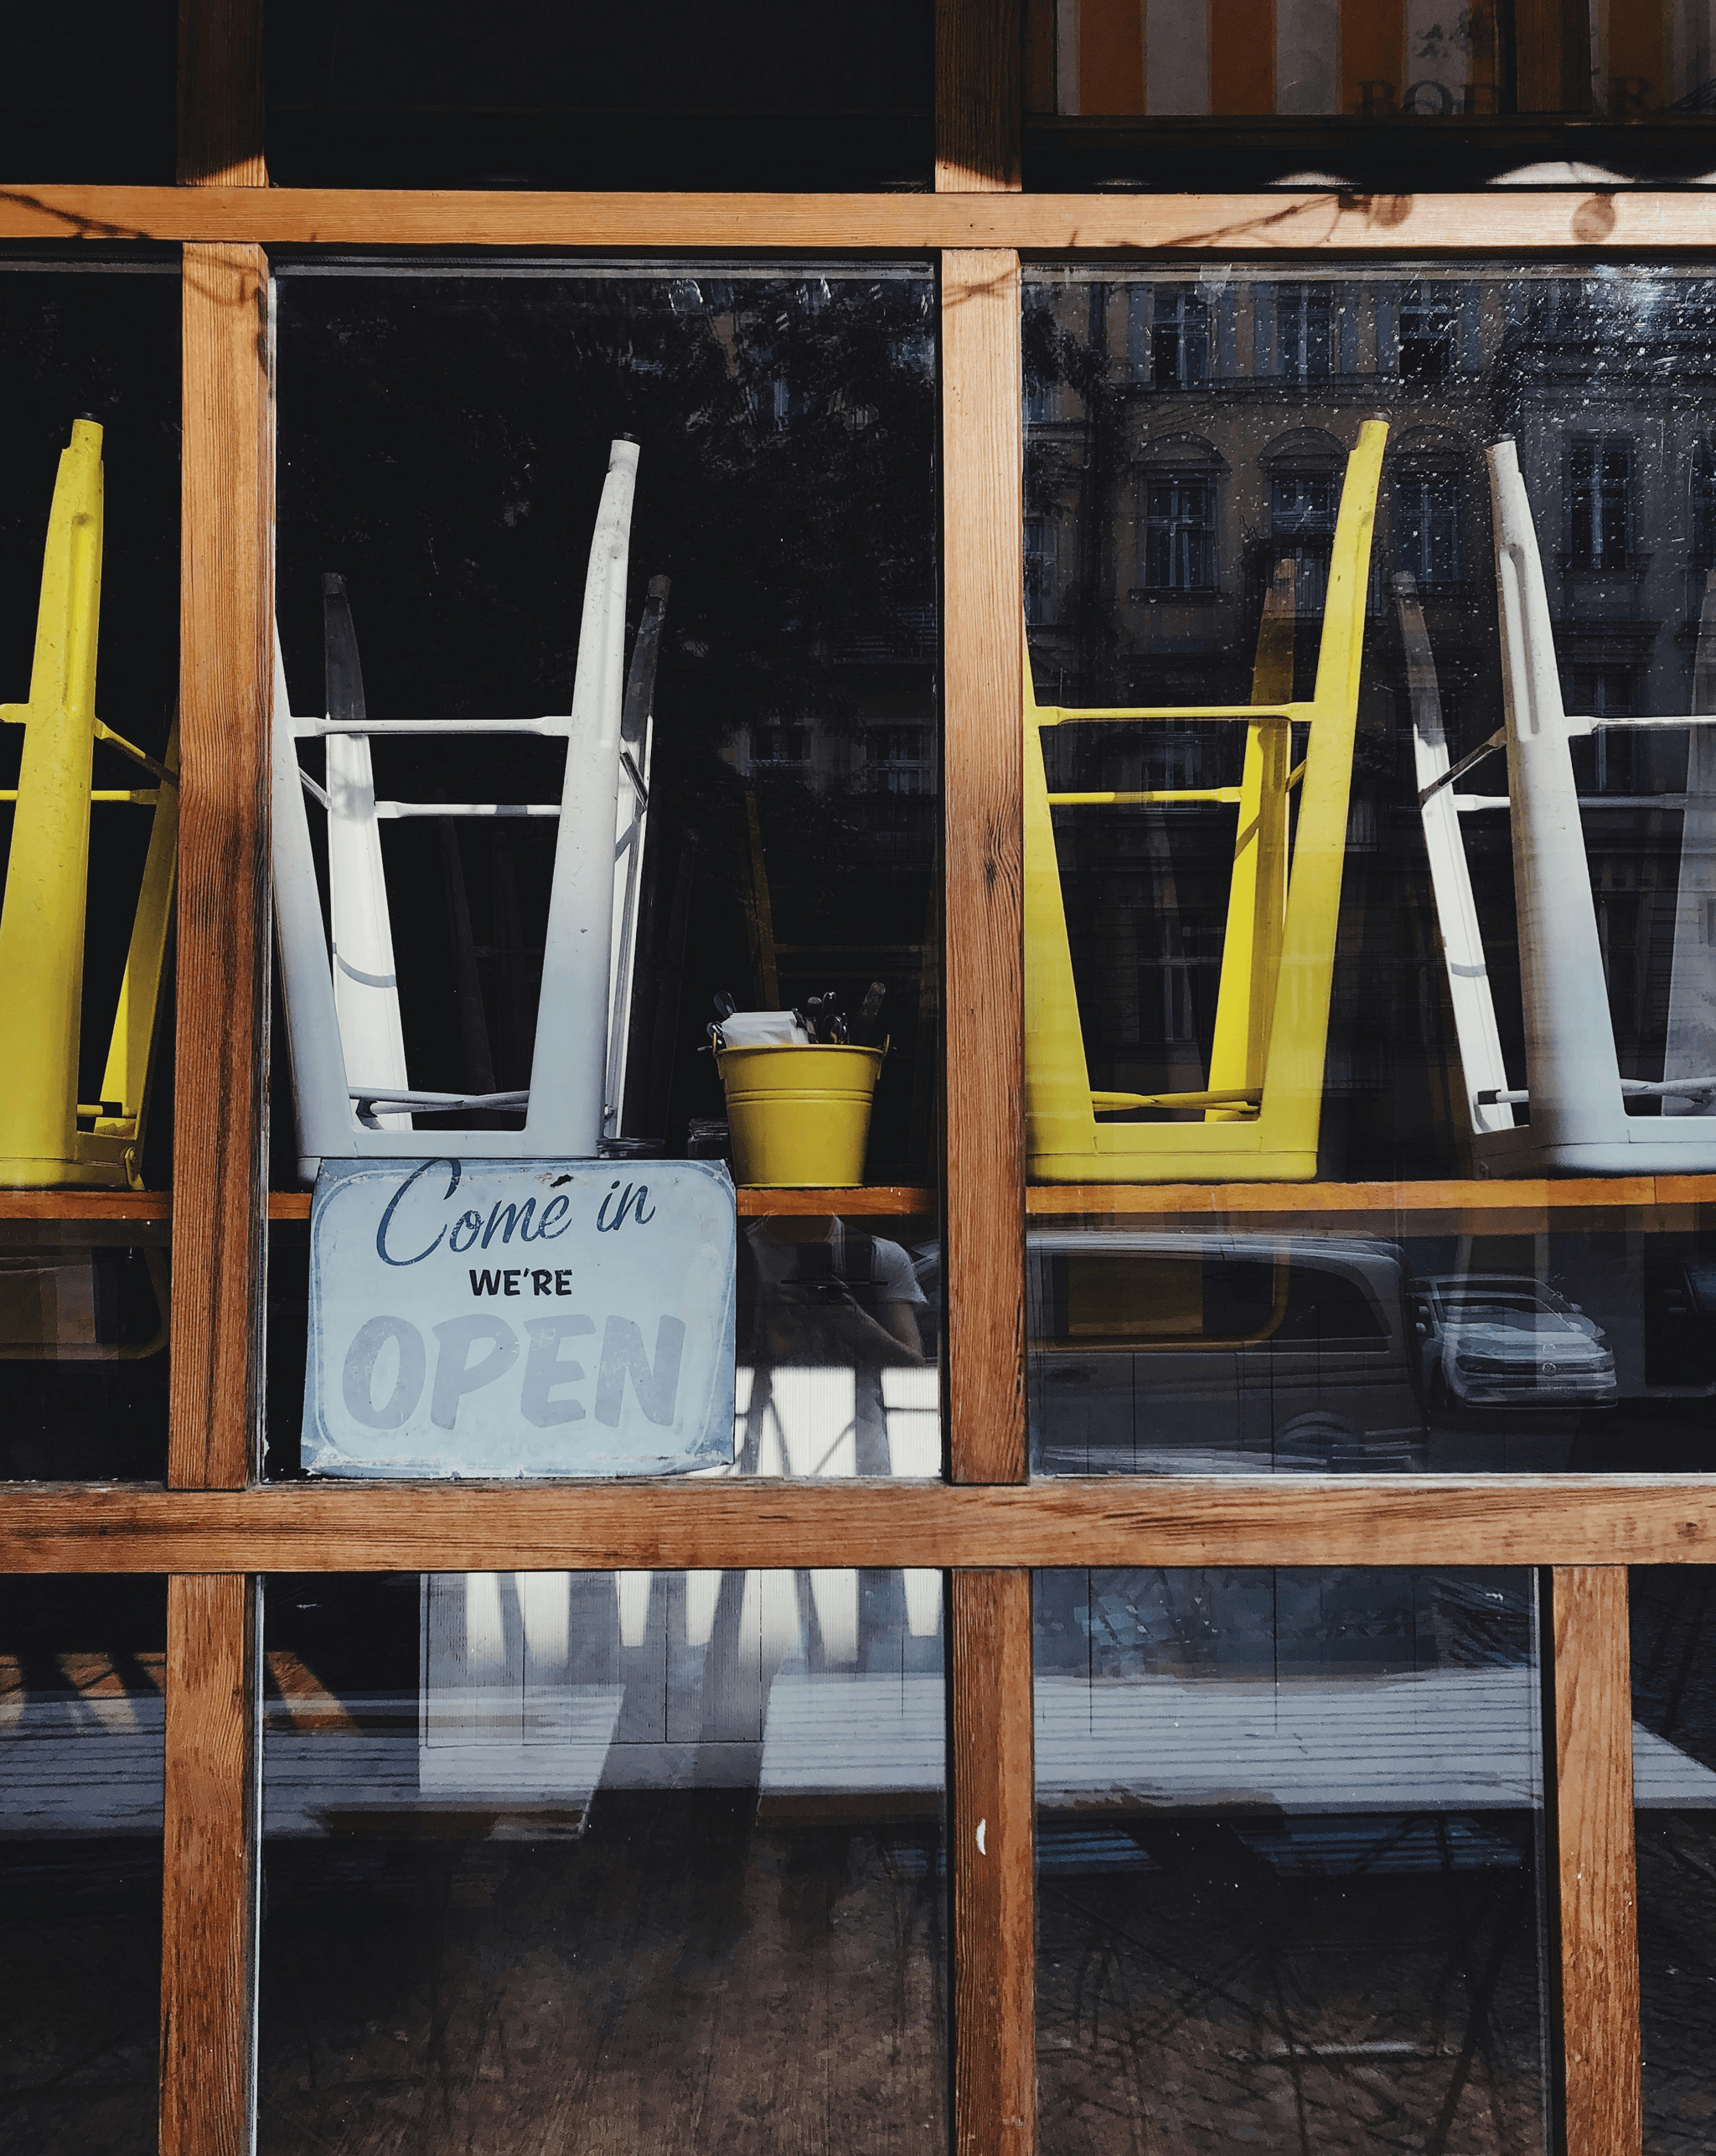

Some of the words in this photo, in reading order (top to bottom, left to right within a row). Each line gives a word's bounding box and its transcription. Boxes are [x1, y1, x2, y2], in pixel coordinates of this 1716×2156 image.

[376, 1159, 572, 1266] Come
[596, 1180, 656, 1233] in
[468, 1268, 572, 1296] WE'RE
[342, 1313, 686, 1430] OPEN
